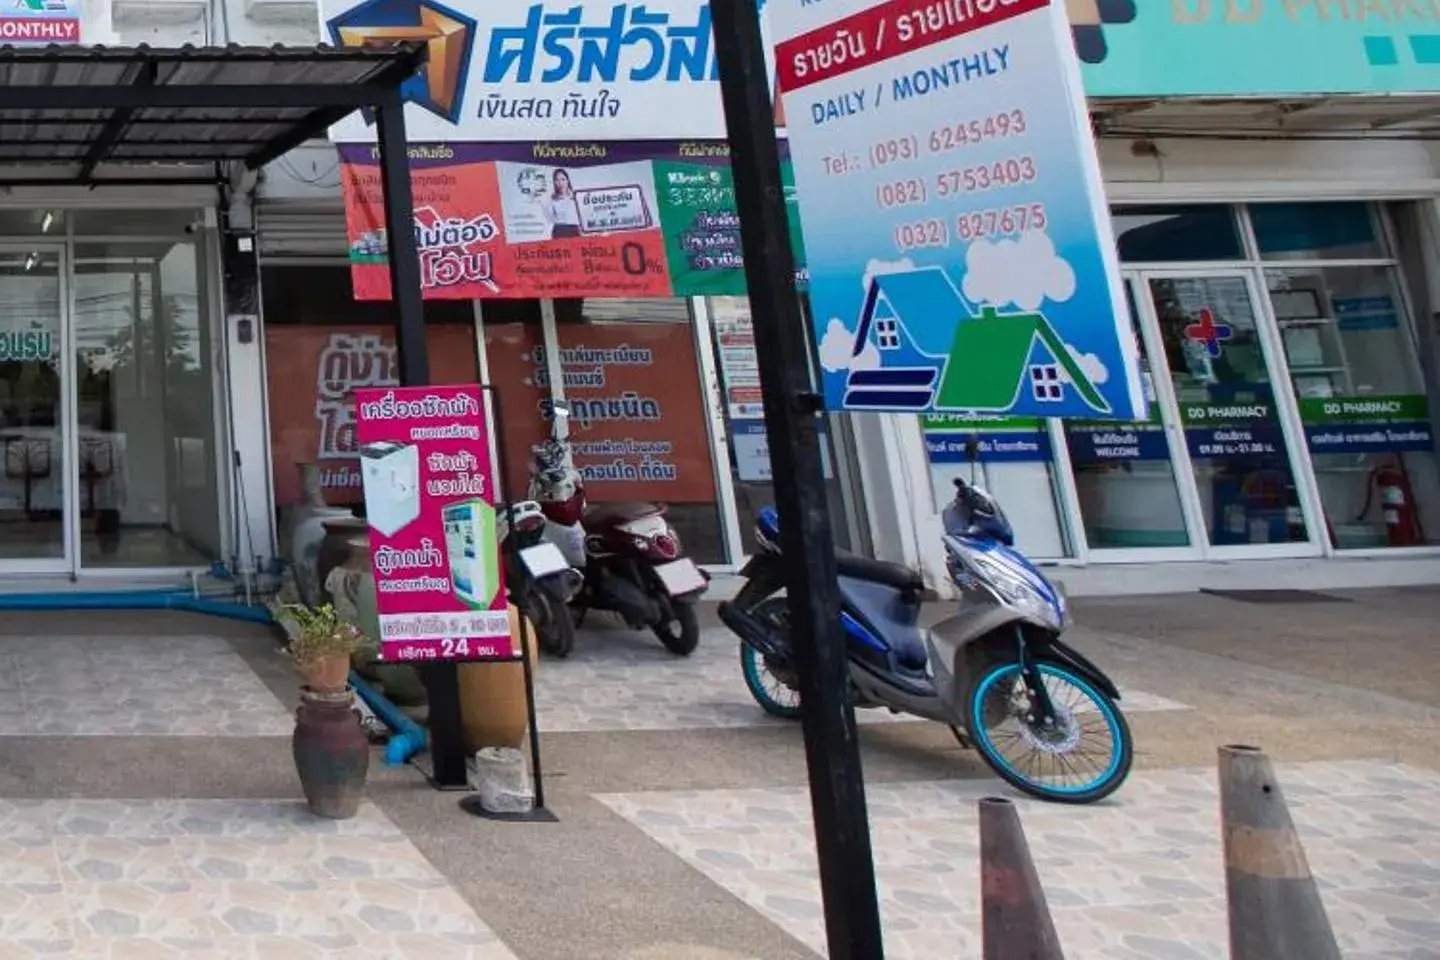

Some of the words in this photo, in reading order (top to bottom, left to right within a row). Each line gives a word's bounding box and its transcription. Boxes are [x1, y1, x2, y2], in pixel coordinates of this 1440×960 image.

[793, 28, 866, 78] รายวัน
[811, 88, 867, 125] DAILY
[891, 44, 1011, 102] MONTHLY
[477, 92, 552, 120] เงินสด
[562, 90, 621, 120] ทันใจ
[868, 136, 919, 168] (093)
[928, 109, 1027, 152] 6245493
[875, 178, 927, 208] (082)
[937, 156, 1037, 197] 5753403
[894, 219, 949, 253] (032)
[958, 204, 1047, 240] 827675
[361, 391, 479, 420] เครื่องซักผ้า
[1188, 406, 1205, 418] DD
[1207, 405, 1268, 418] PHARMACY
[1323, 402, 1341, 415] DD
[1343, 401, 1402, 414] PHARMACY
[441, 637, 470, 658] 24
